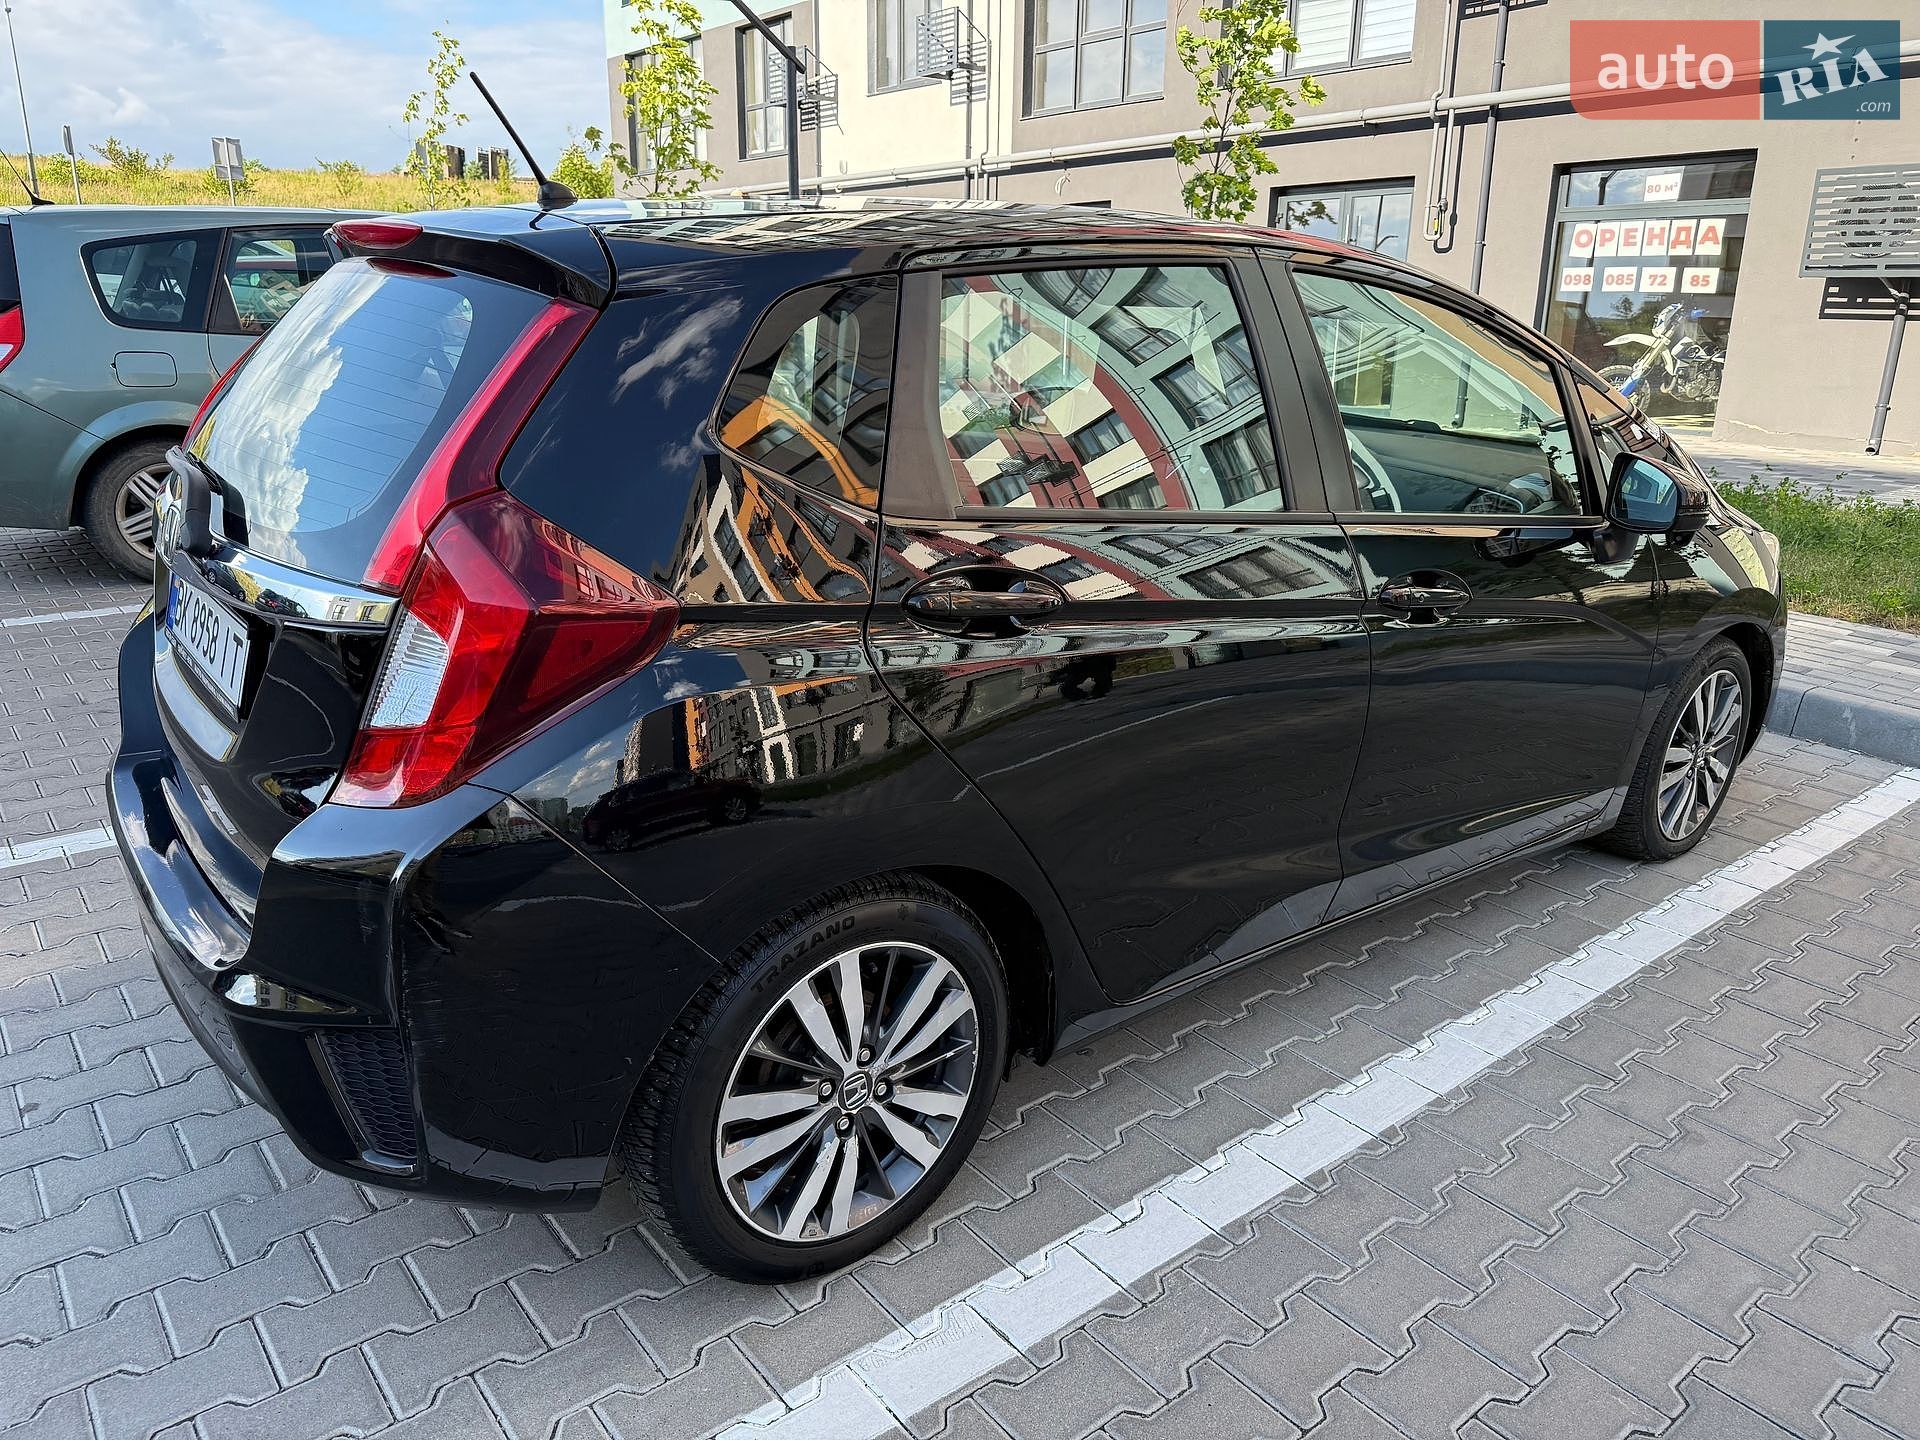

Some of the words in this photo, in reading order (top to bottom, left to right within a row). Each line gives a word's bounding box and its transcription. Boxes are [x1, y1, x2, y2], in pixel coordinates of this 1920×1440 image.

[1646, 184, 1662, 194] 80
[1574, 225, 1720, 250] ОРЕНДА
[1563, 273, 1592, 286] 098
[1605, 273, 1634, 286] 085
[1648, 273, 1667, 286] 72
[1689, 274, 1710, 287] 85
[175, 580, 194, 638] BK
[190, 597, 220, 665] 8958
[221, 626, 243, 688] IT
[750, 915, 856, 993] TRAZANO
